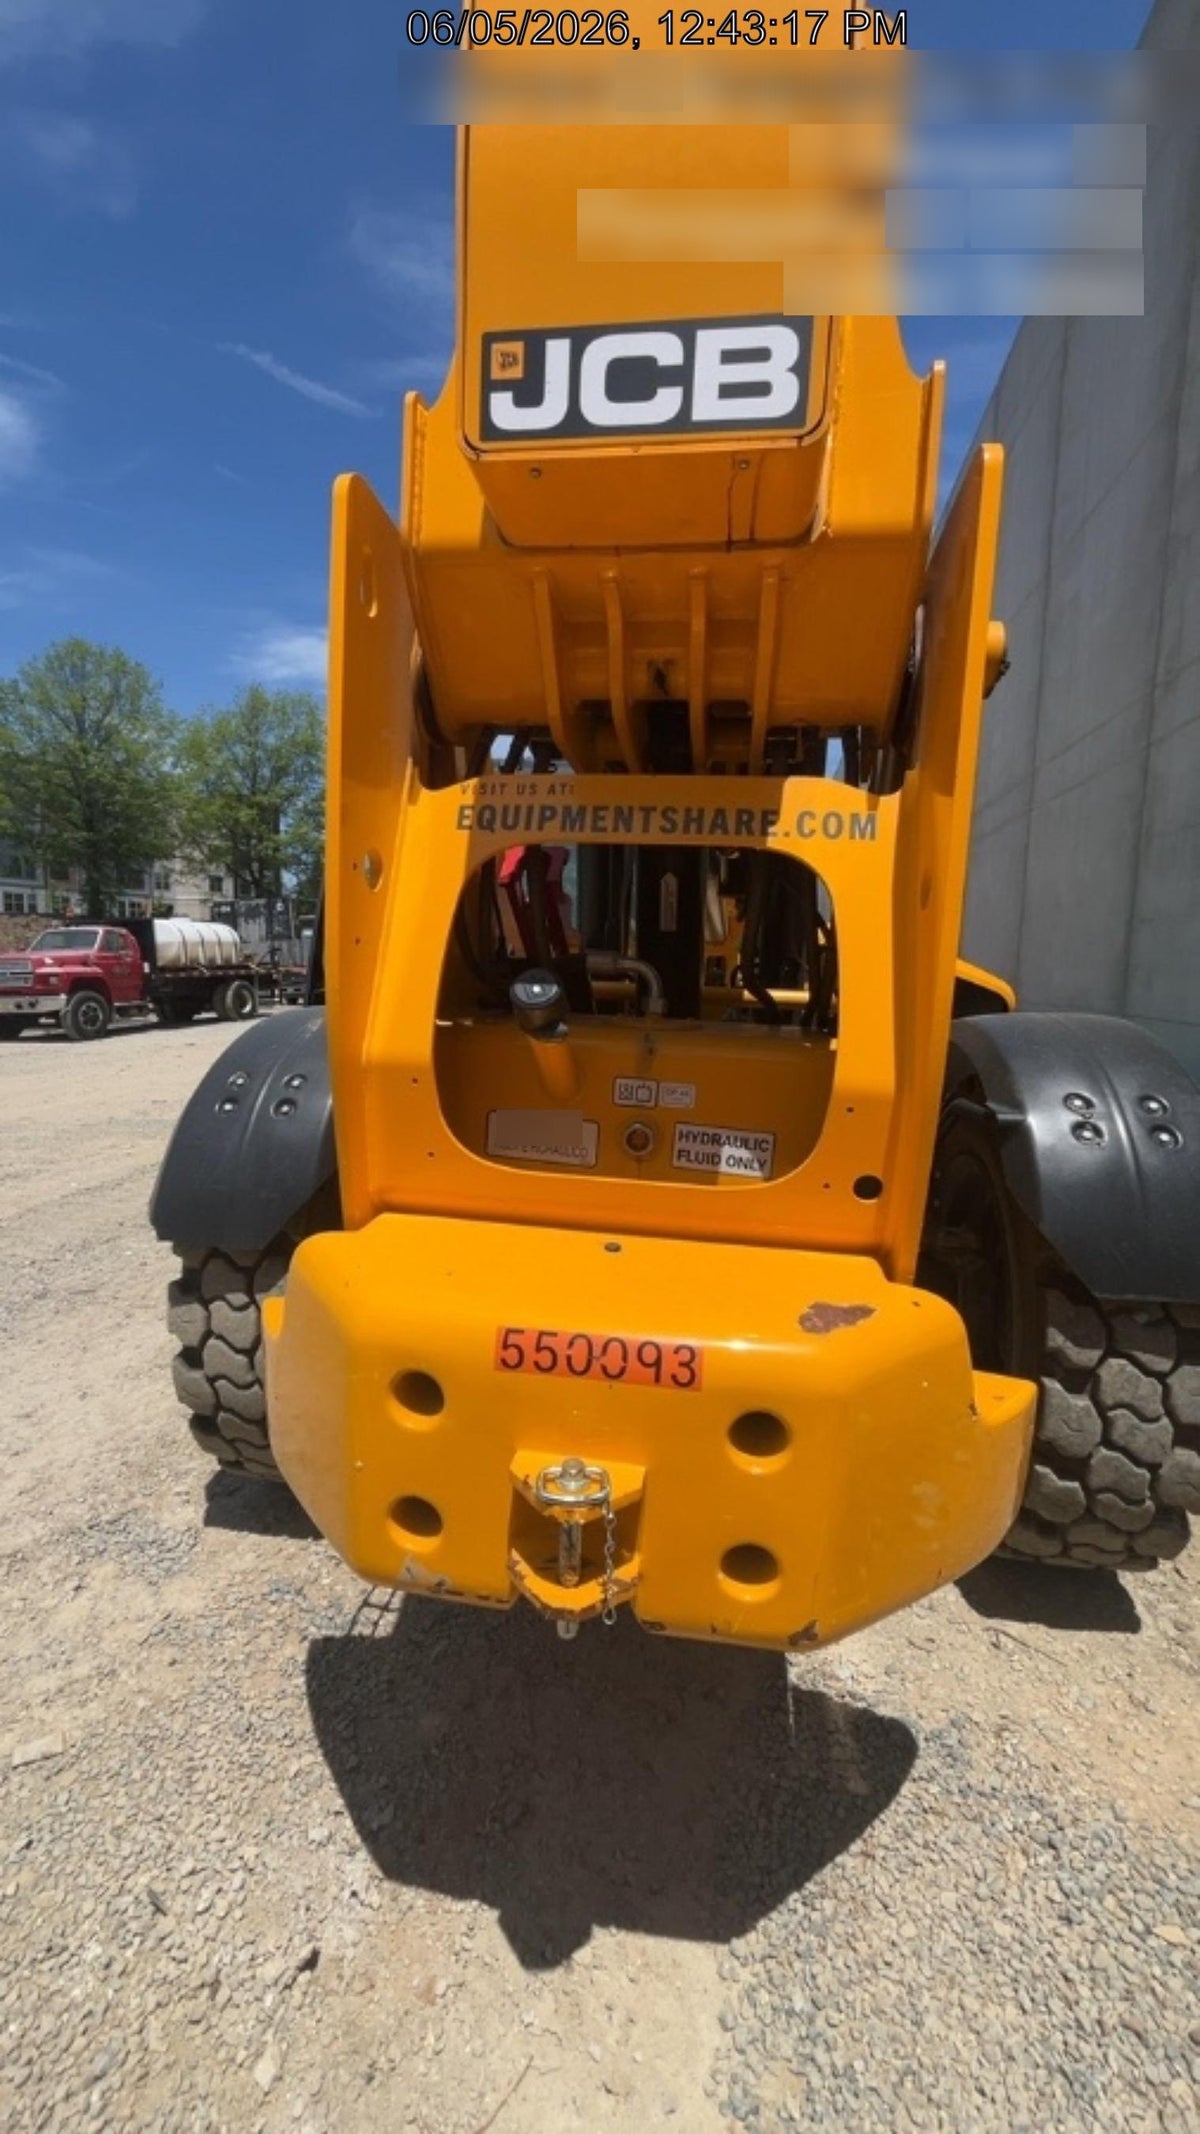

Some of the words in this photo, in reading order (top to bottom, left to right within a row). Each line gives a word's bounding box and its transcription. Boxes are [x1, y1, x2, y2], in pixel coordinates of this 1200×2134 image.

[489, 325, 800, 431] JCB
[460, 783, 507, 797] VISIT
[516, 783, 539, 796] US
[455, 803, 878, 841] EQUIPMENTSHARE.COM
[677, 1129, 770, 1153] HYDRAULIC
[677, 1149, 722, 1167] FLUID
[725, 1153, 767, 1171] ONLY
[500, 1327, 697, 1389] 550093
